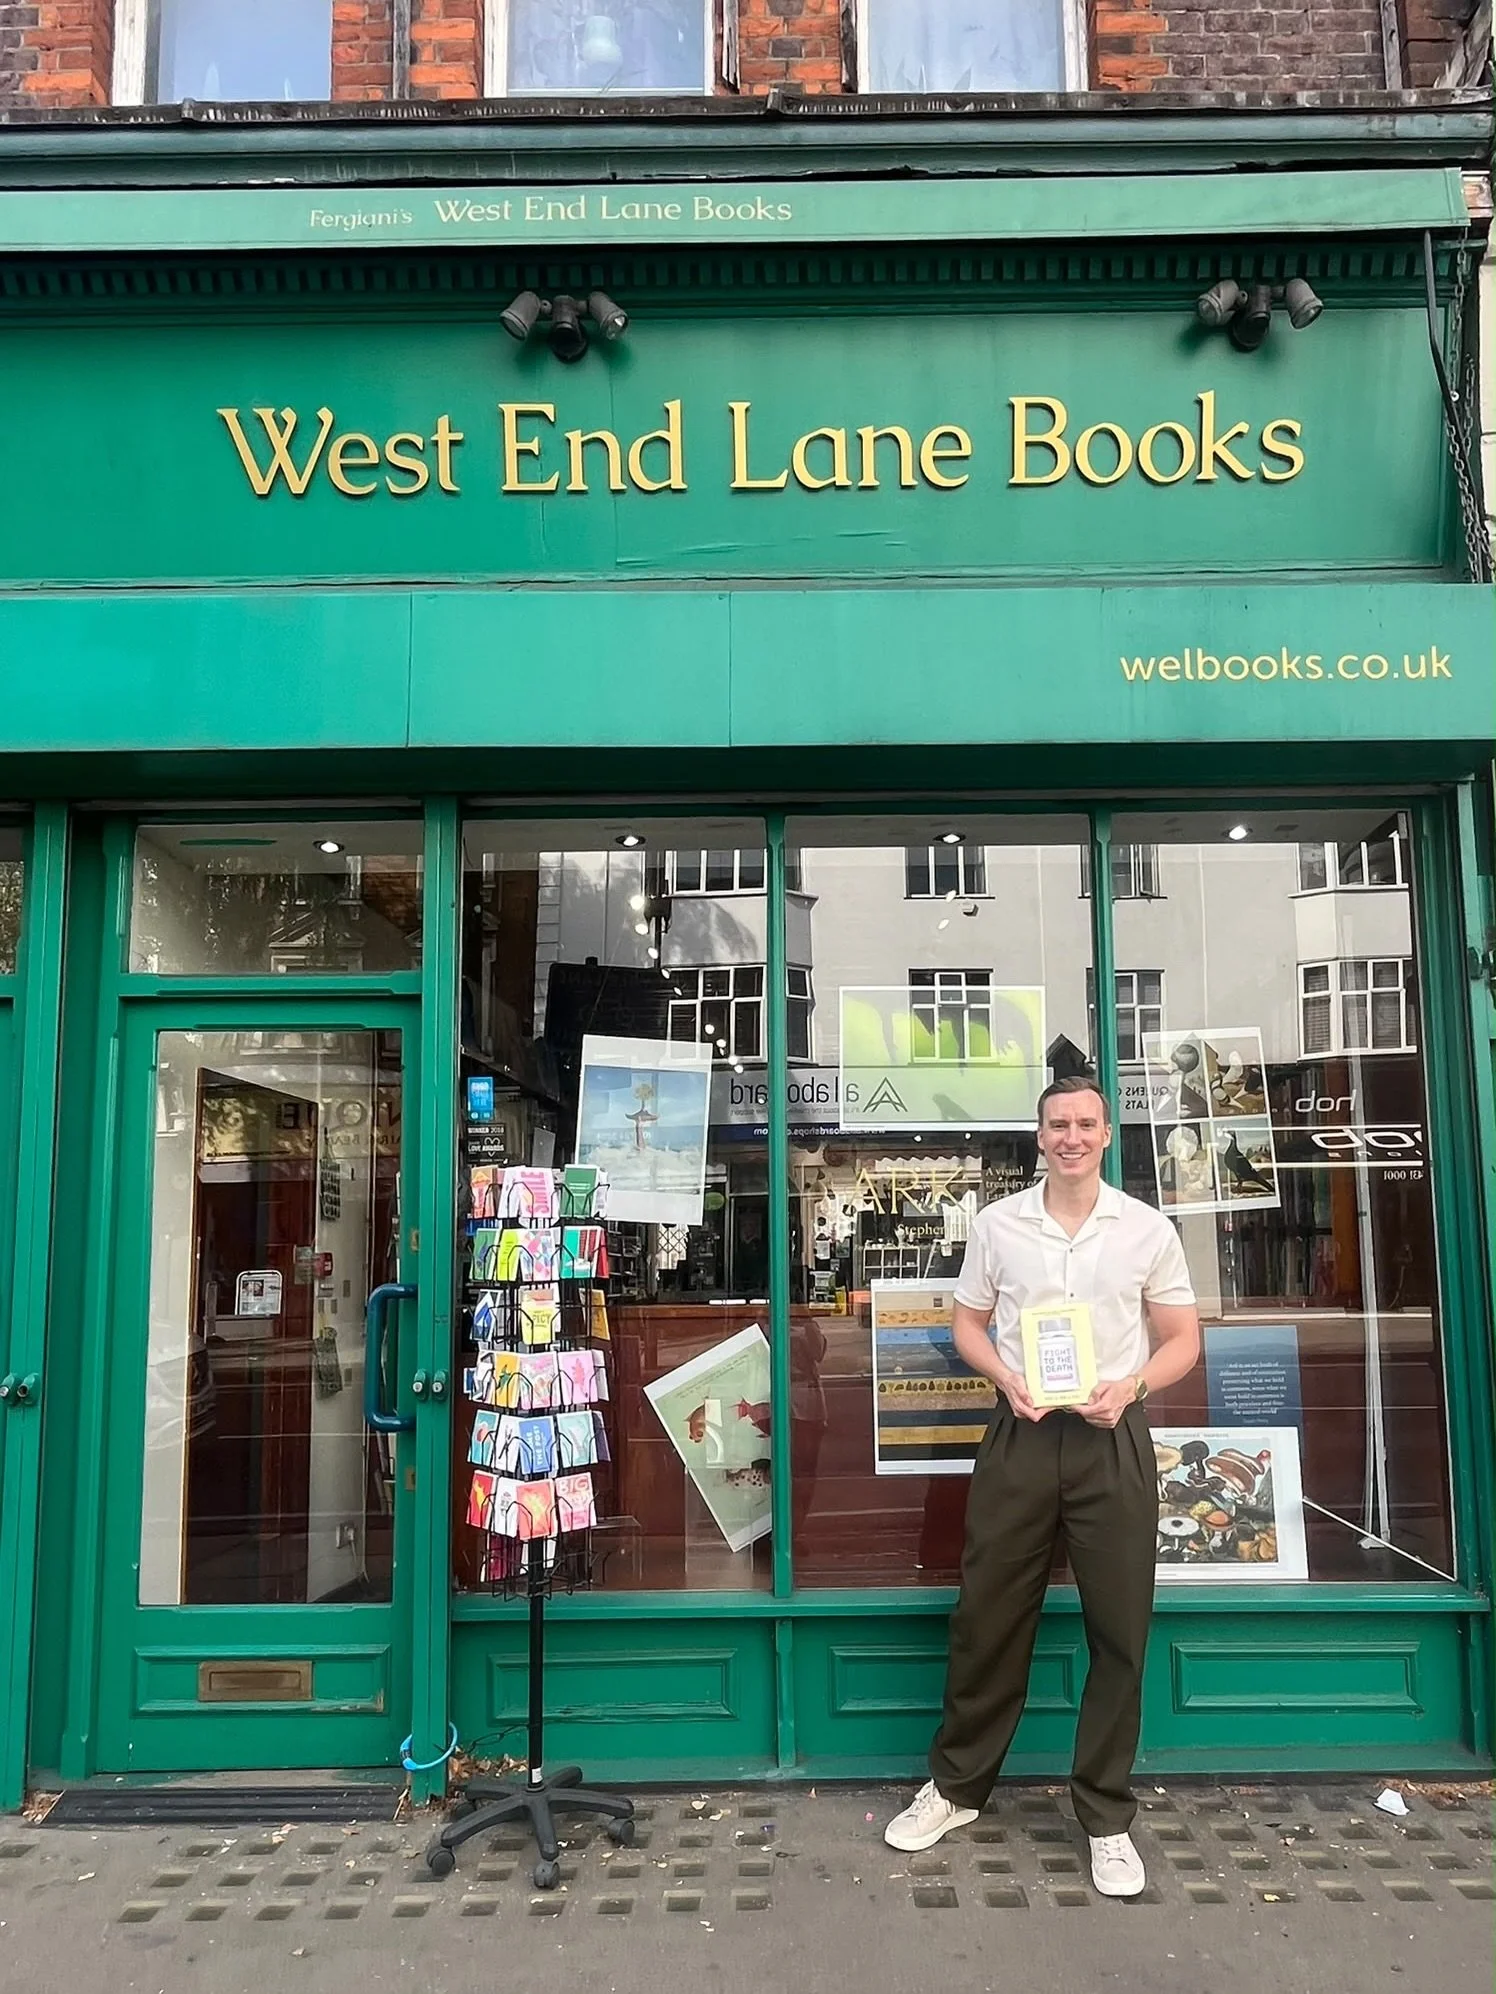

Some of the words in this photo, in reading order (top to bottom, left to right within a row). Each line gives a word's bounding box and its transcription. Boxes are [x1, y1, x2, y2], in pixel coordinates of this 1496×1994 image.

[434, 198, 513, 222] West
[524, 195, 586, 221] End
[600, 195, 682, 220] Lane
[693, 195, 793, 220] Books
[217, 405, 464, 496] West
[499, 399, 687, 494] End
[729, 401, 972, 490] Lane
[1008, 390, 1305, 486] Books
[1120, 646, 1453, 683] welbooks.co.uk
[985, 1167, 994, 1177] A
[995, 1165, 1023, 1176] visual
[844, 1165, 967, 1215] ARK
[1044, 1347, 1072, 1357] FIGHT
[1044, 1357, 1056, 1366] TO
[1057, 1355, 1072, 1364] THE
[1045, 1364, 1073, 1374] DEATH
[559, 1475, 590, 1494] BIG
